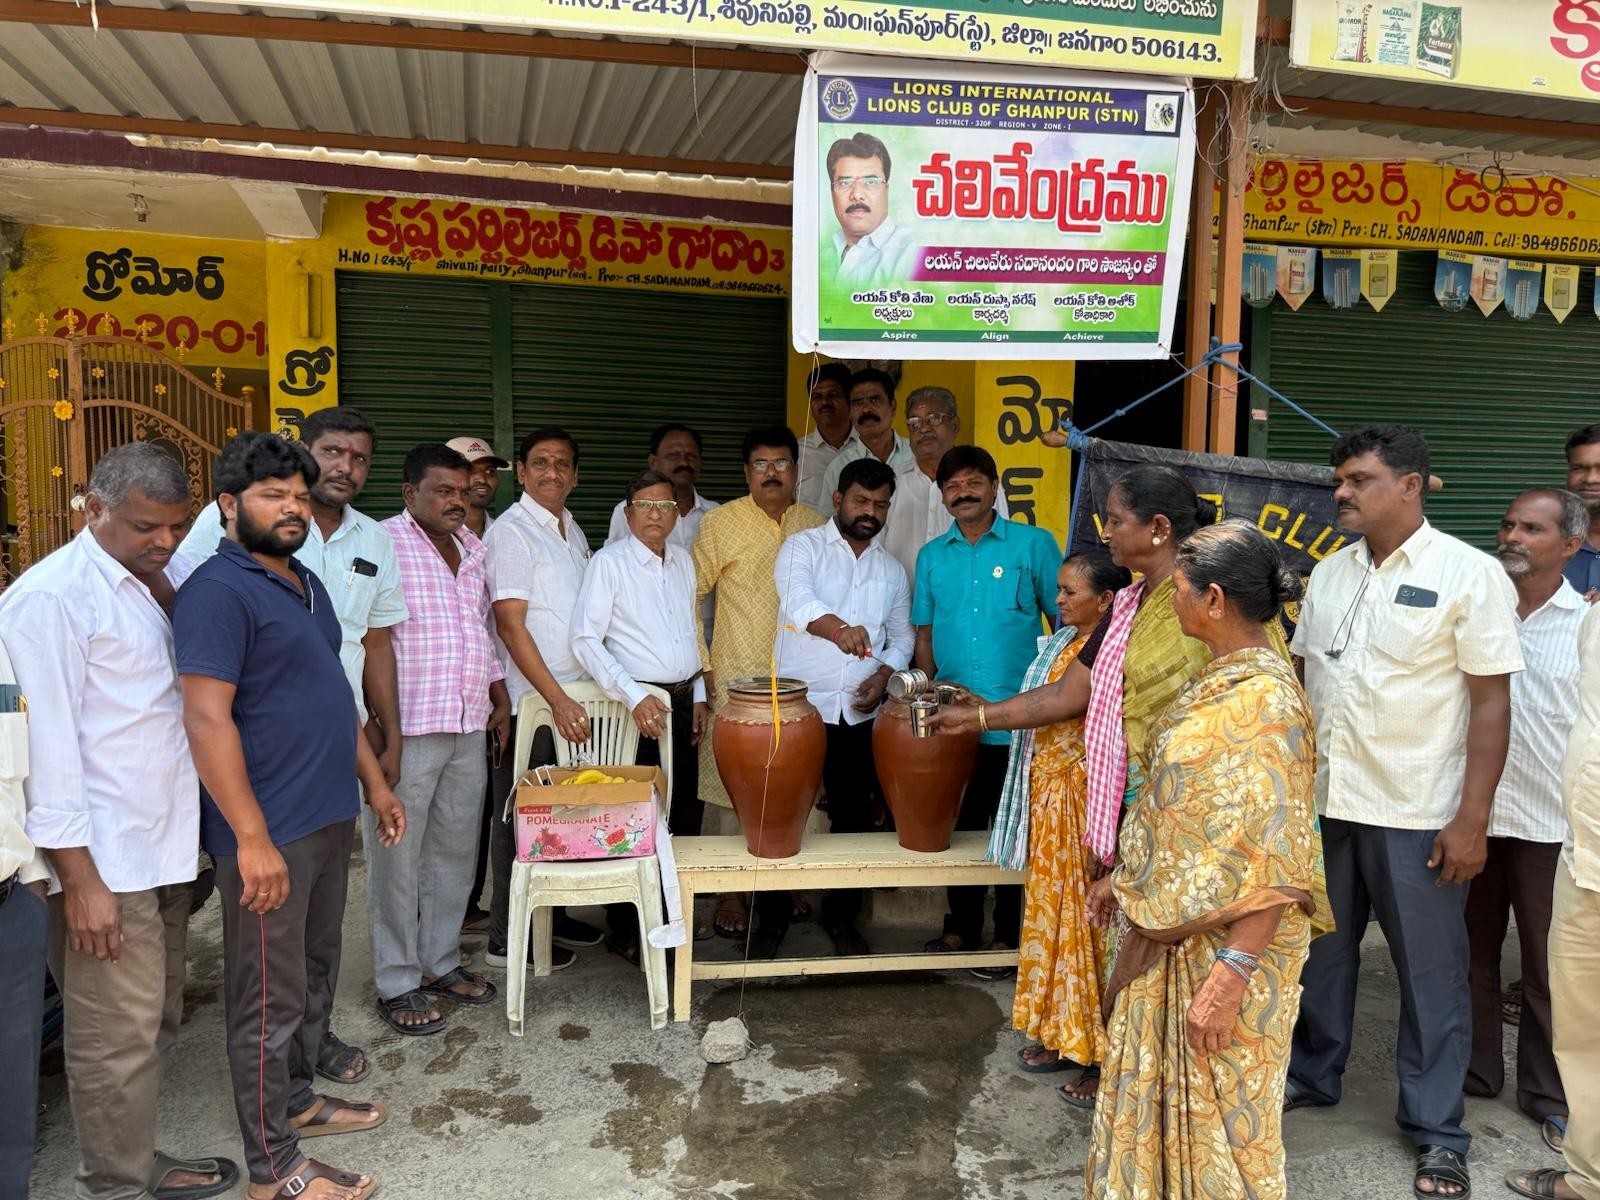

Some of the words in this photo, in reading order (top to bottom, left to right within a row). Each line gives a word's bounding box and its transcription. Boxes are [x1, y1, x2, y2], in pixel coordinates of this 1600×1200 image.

[1131, 36, 1222, 63] 506143.
[893, 82, 953, 96] LIONS
[960, 85, 1115, 104] INTERNATIONAL
[867, 98, 921, 114] LIONS
[927, 101, 973, 116] CLUB
[979, 103, 1001, 117] OF
[1006, 104, 1090, 121] GHANPUR
[1094, 107, 1139, 126] (STN)
[936, 118, 969, 126] DISTRICT
[999, 121, 1026, 129] REGION
[912, 141, 1168, 233] చలివేంద్రము
[769, 249, 785, 272] 3
[925, 251, 962, 271] లయన్
[1014, 254, 1074, 273] సదానందం
[1076, 256, 1098, 273] గారి
[852, 291, 888, 303] లయన్
[947, 292, 981, 305] లయన్
[1054, 293, 1086, 306] లయన్
[881, 331, 918, 341] Aspire
[981, 331, 1009, 342] Align
[1063, 332, 1104, 341] Achieve
[1257, 502, 1345, 562] CLU
